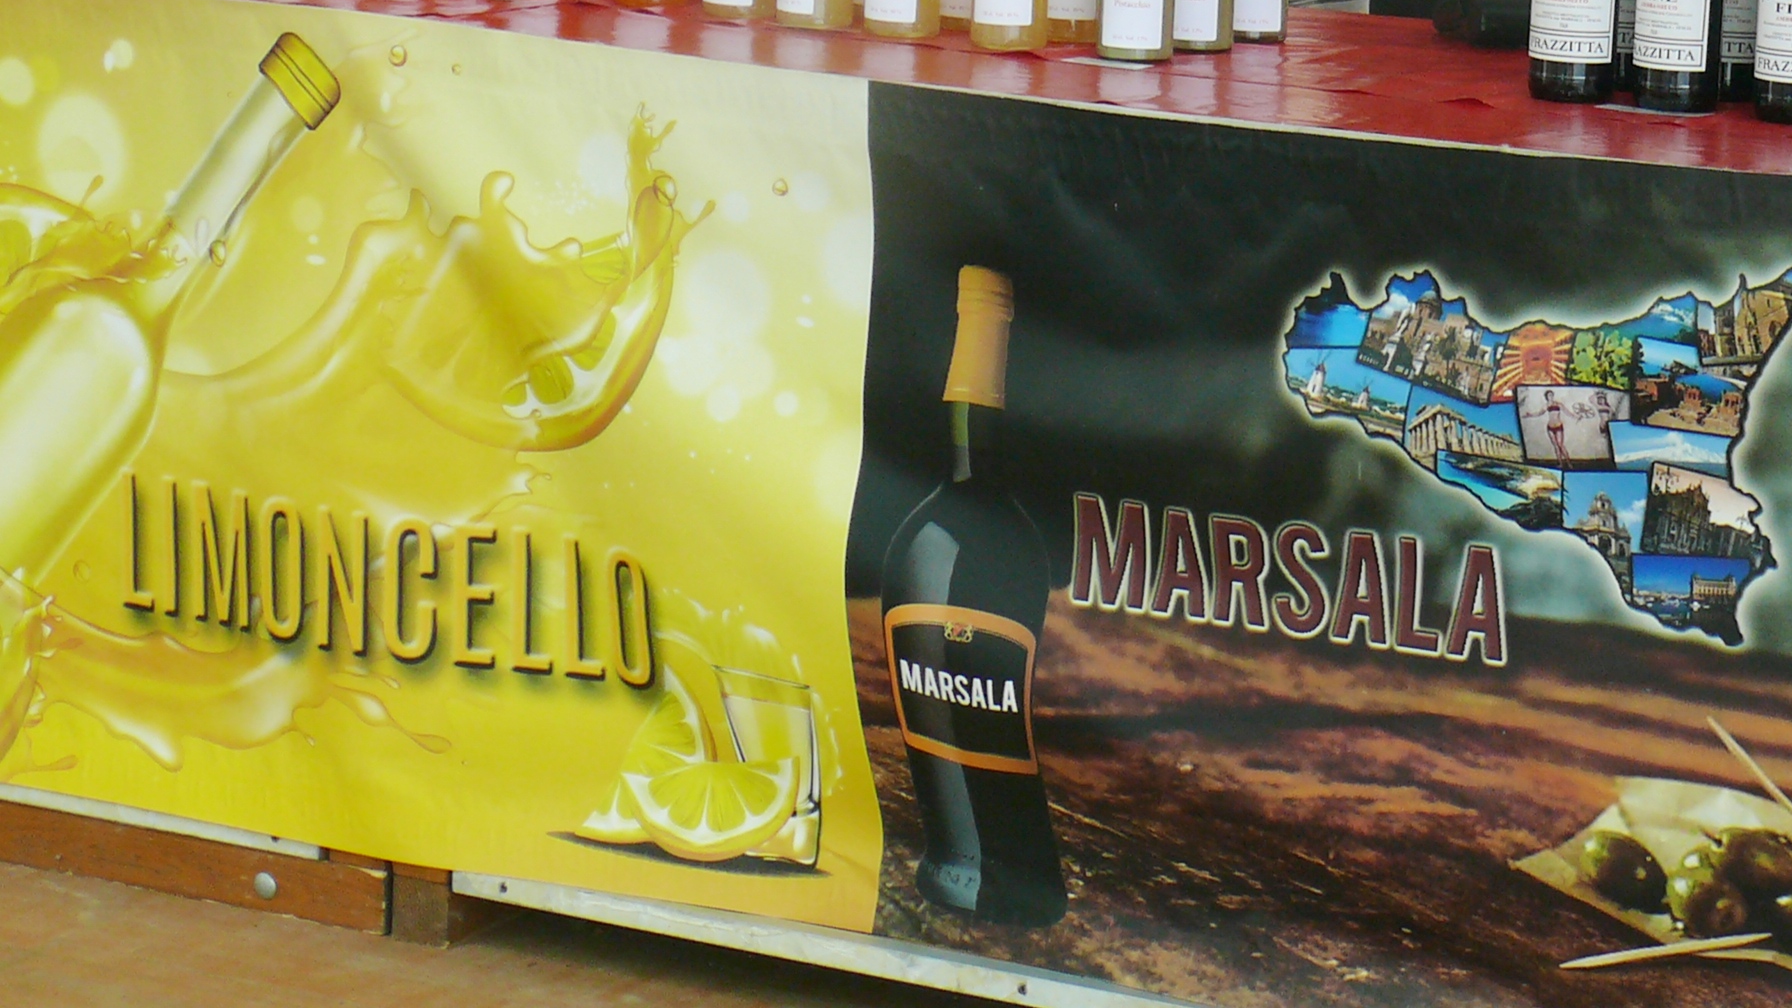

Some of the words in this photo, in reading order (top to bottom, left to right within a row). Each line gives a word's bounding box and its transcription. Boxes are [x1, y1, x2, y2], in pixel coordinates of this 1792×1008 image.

[1531, 36, 1604, 53] FRAZZITTA
[121, 470, 656, 689] LIMONCELLO
[1071, 492, 1507, 666] MARSALA
[900, 658, 1018, 713] MARSALA
